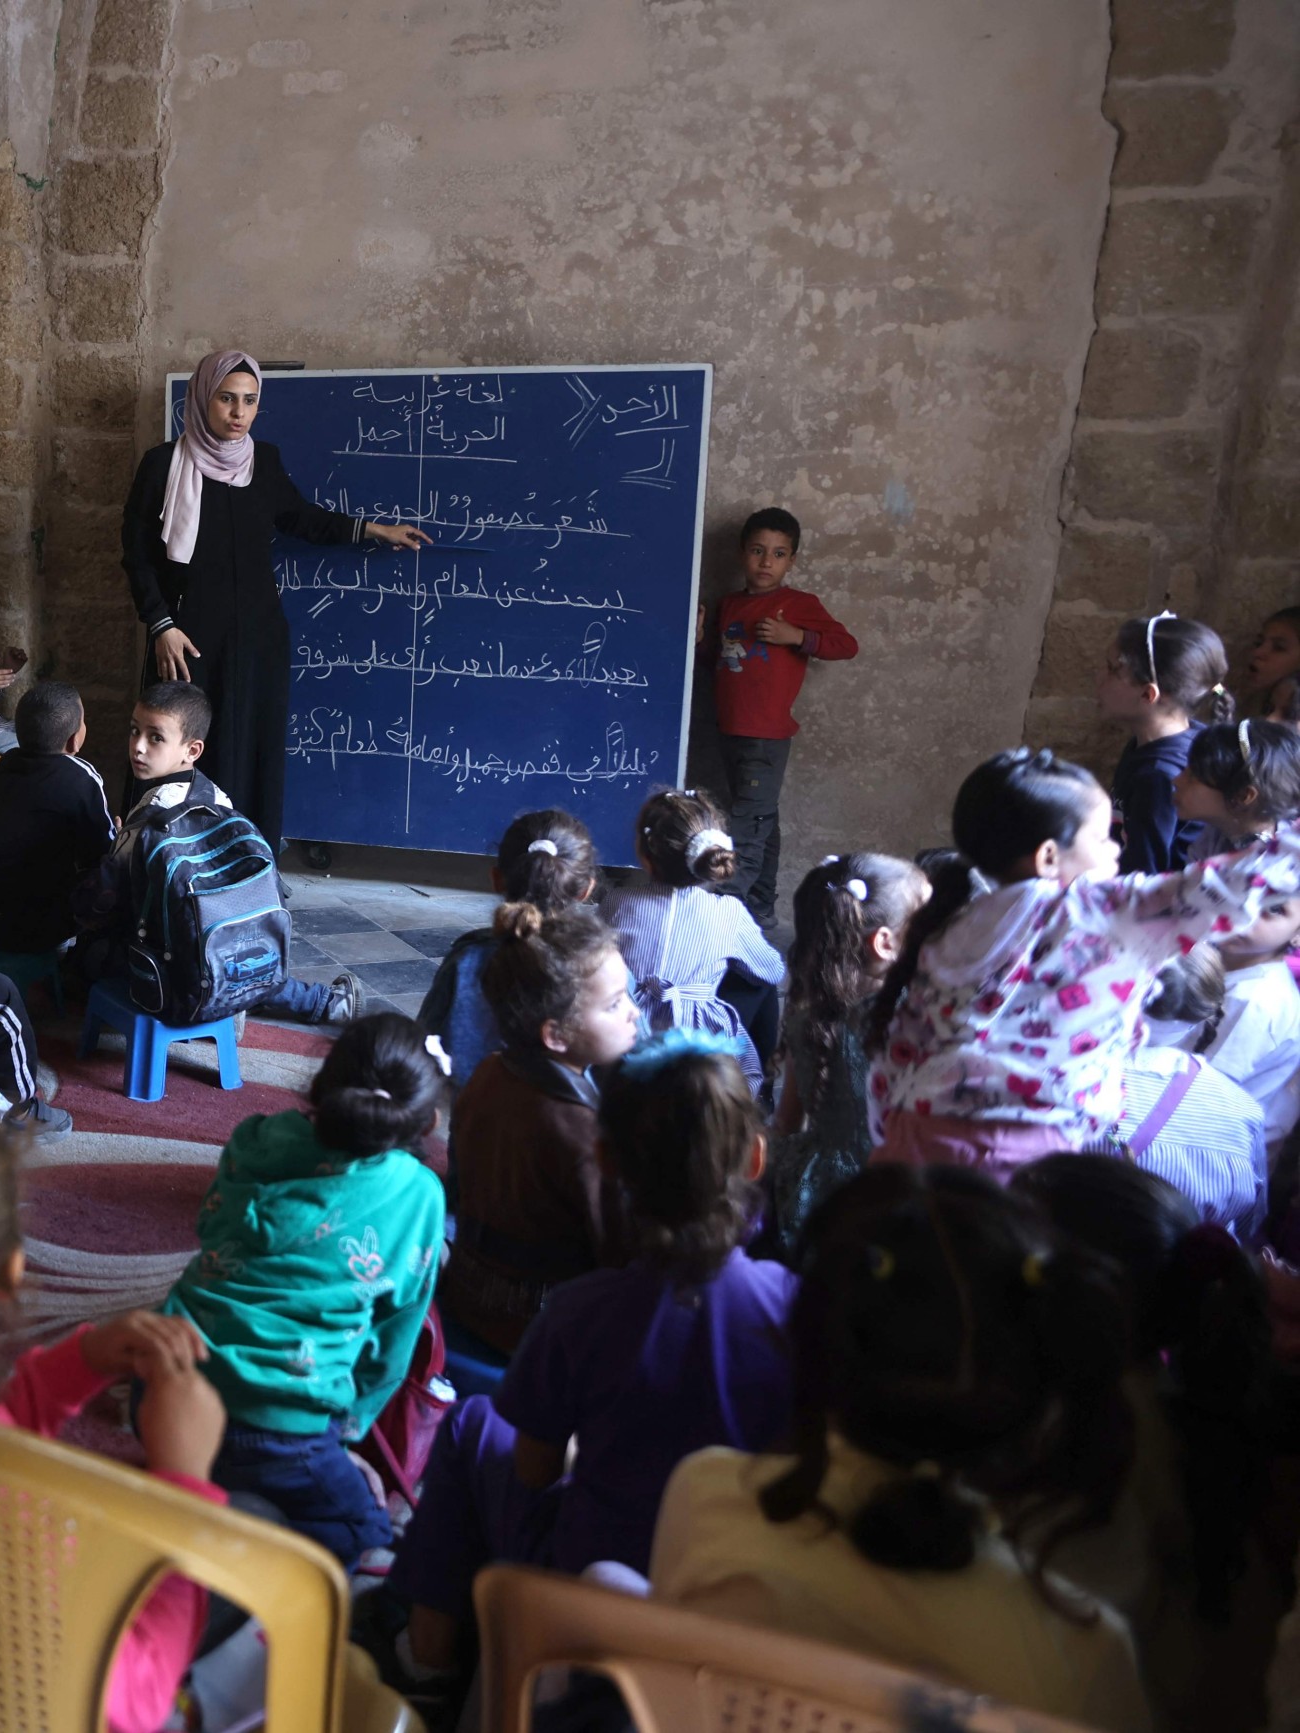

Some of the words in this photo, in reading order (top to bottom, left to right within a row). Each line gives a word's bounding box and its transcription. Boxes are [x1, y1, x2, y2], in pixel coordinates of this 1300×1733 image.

[455, 374, 504, 404] لغة
[602, 384, 678, 424] الأحد
[496, 582, 530, 608] عن
[354, 640, 389, 674] على
[566, 747, 601, 795] في
